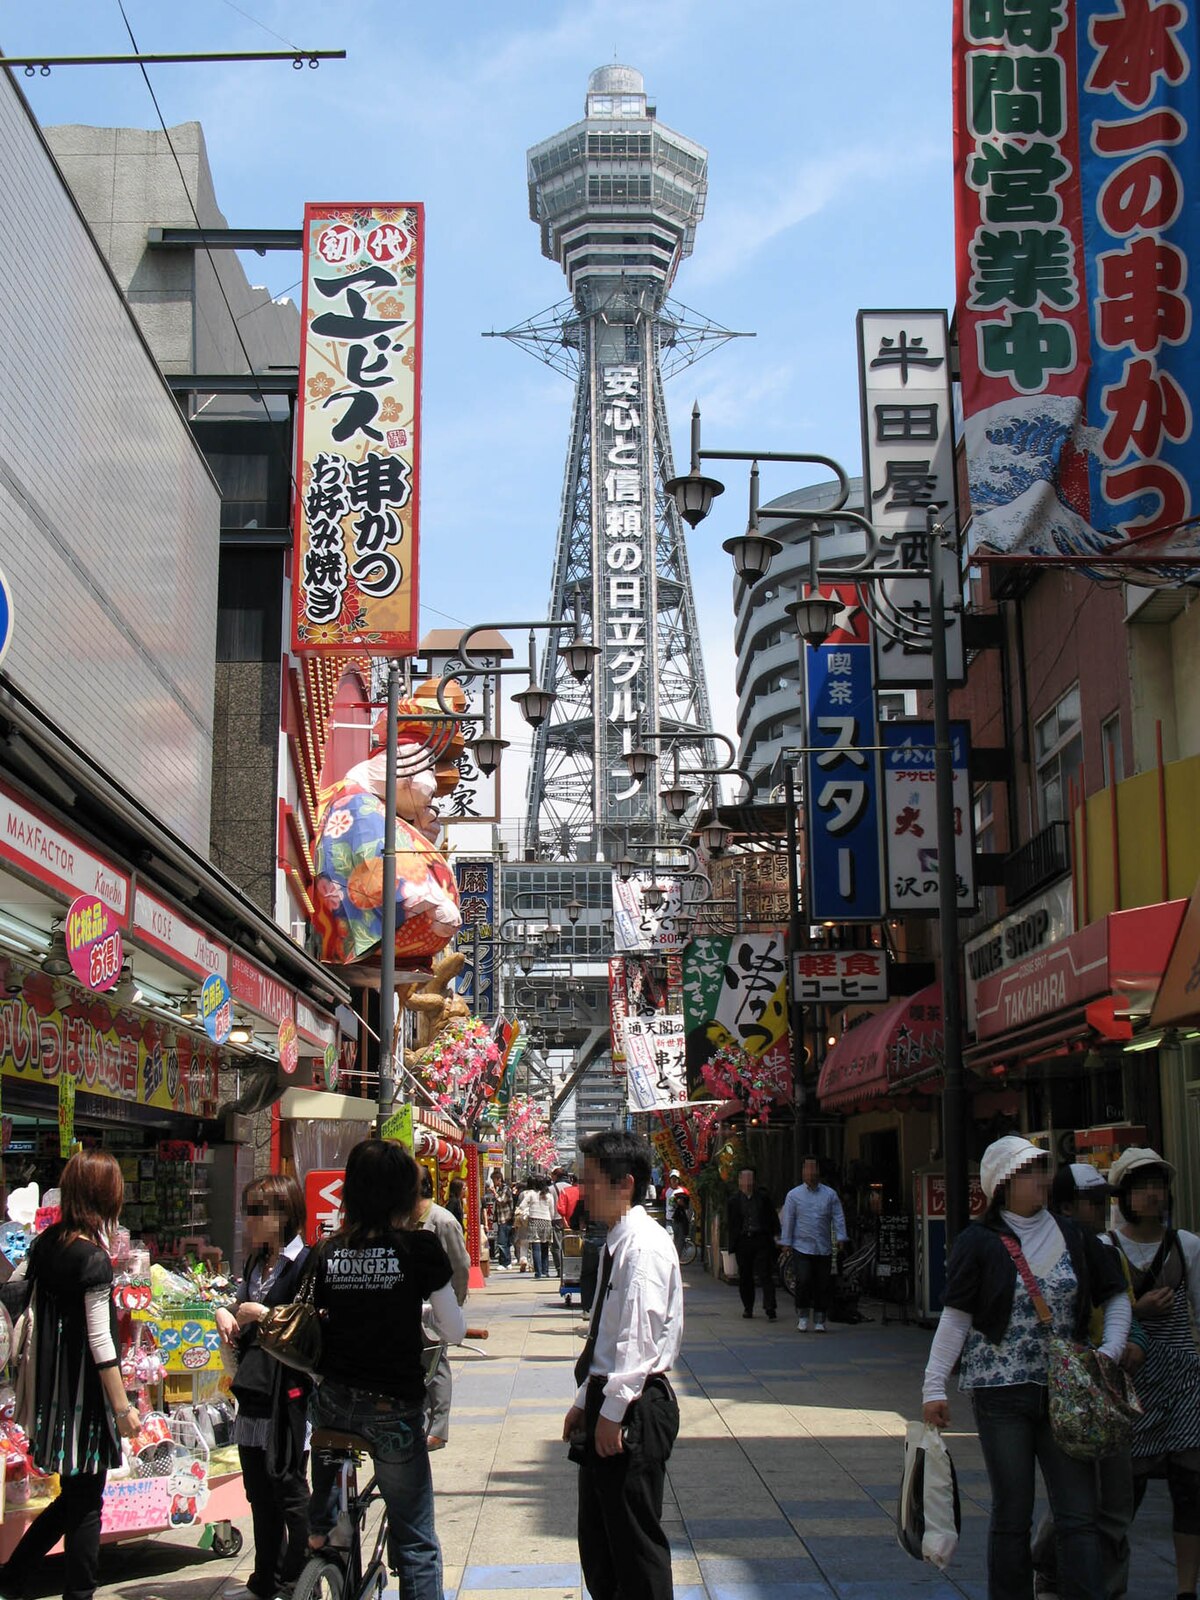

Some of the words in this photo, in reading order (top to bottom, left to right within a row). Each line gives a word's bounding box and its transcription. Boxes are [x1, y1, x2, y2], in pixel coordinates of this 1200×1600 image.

[321, 226, 404, 262] 初代
[310, 265, 408, 442] エビス
[870, 330, 956, 656] 半田屋酒店
[304, 453, 345, 620] お好み焼き
[347, 452, 406, 594] 串かつ
[604, 365, 645, 801] 安心と信頼の日立グループ
[827, 652, 853, 705] 喫茶
[891, 736, 960, 763] Asai
[816, 715, 867, 898] スター
[458, 865, 490, 925] 麻雀
[1005, 909, 1050, 960] SHOP
[798, 953, 881, 977] 軽食
[802, 979, 878, 998] コーヒー
[724, 941, 784, 1054] 串かつ
[1004, 970, 1067, 1025] TAKAHARA
[326, 1258, 401, 1274] MONGER
[340, 1247, 386, 1258] GOSSIP
